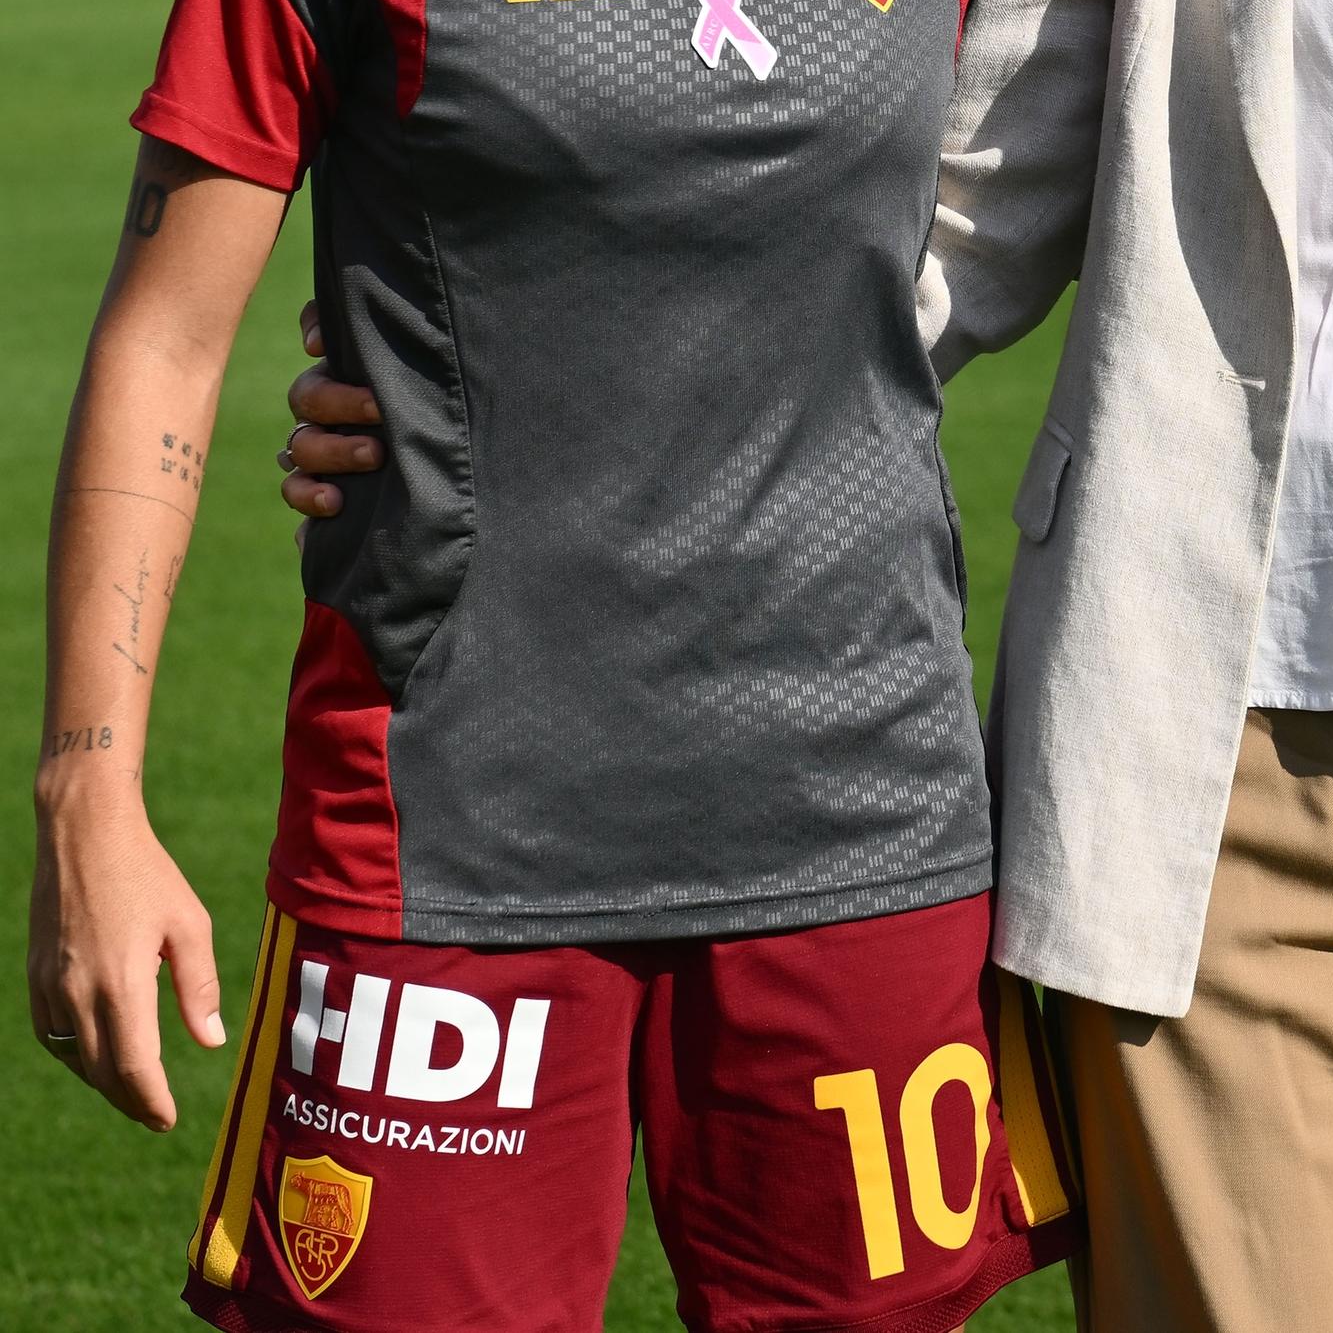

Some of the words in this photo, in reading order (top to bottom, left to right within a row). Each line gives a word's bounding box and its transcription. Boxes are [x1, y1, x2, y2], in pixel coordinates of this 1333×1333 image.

[702, 18, 719, 49] AIRC
[51, 726, 112, 757] 17/18
[291, 960, 551, 1109] HDI
[283, 1093, 526, 1156] ASSICURAZIONI
[813, 1042, 992, 1281] 10
